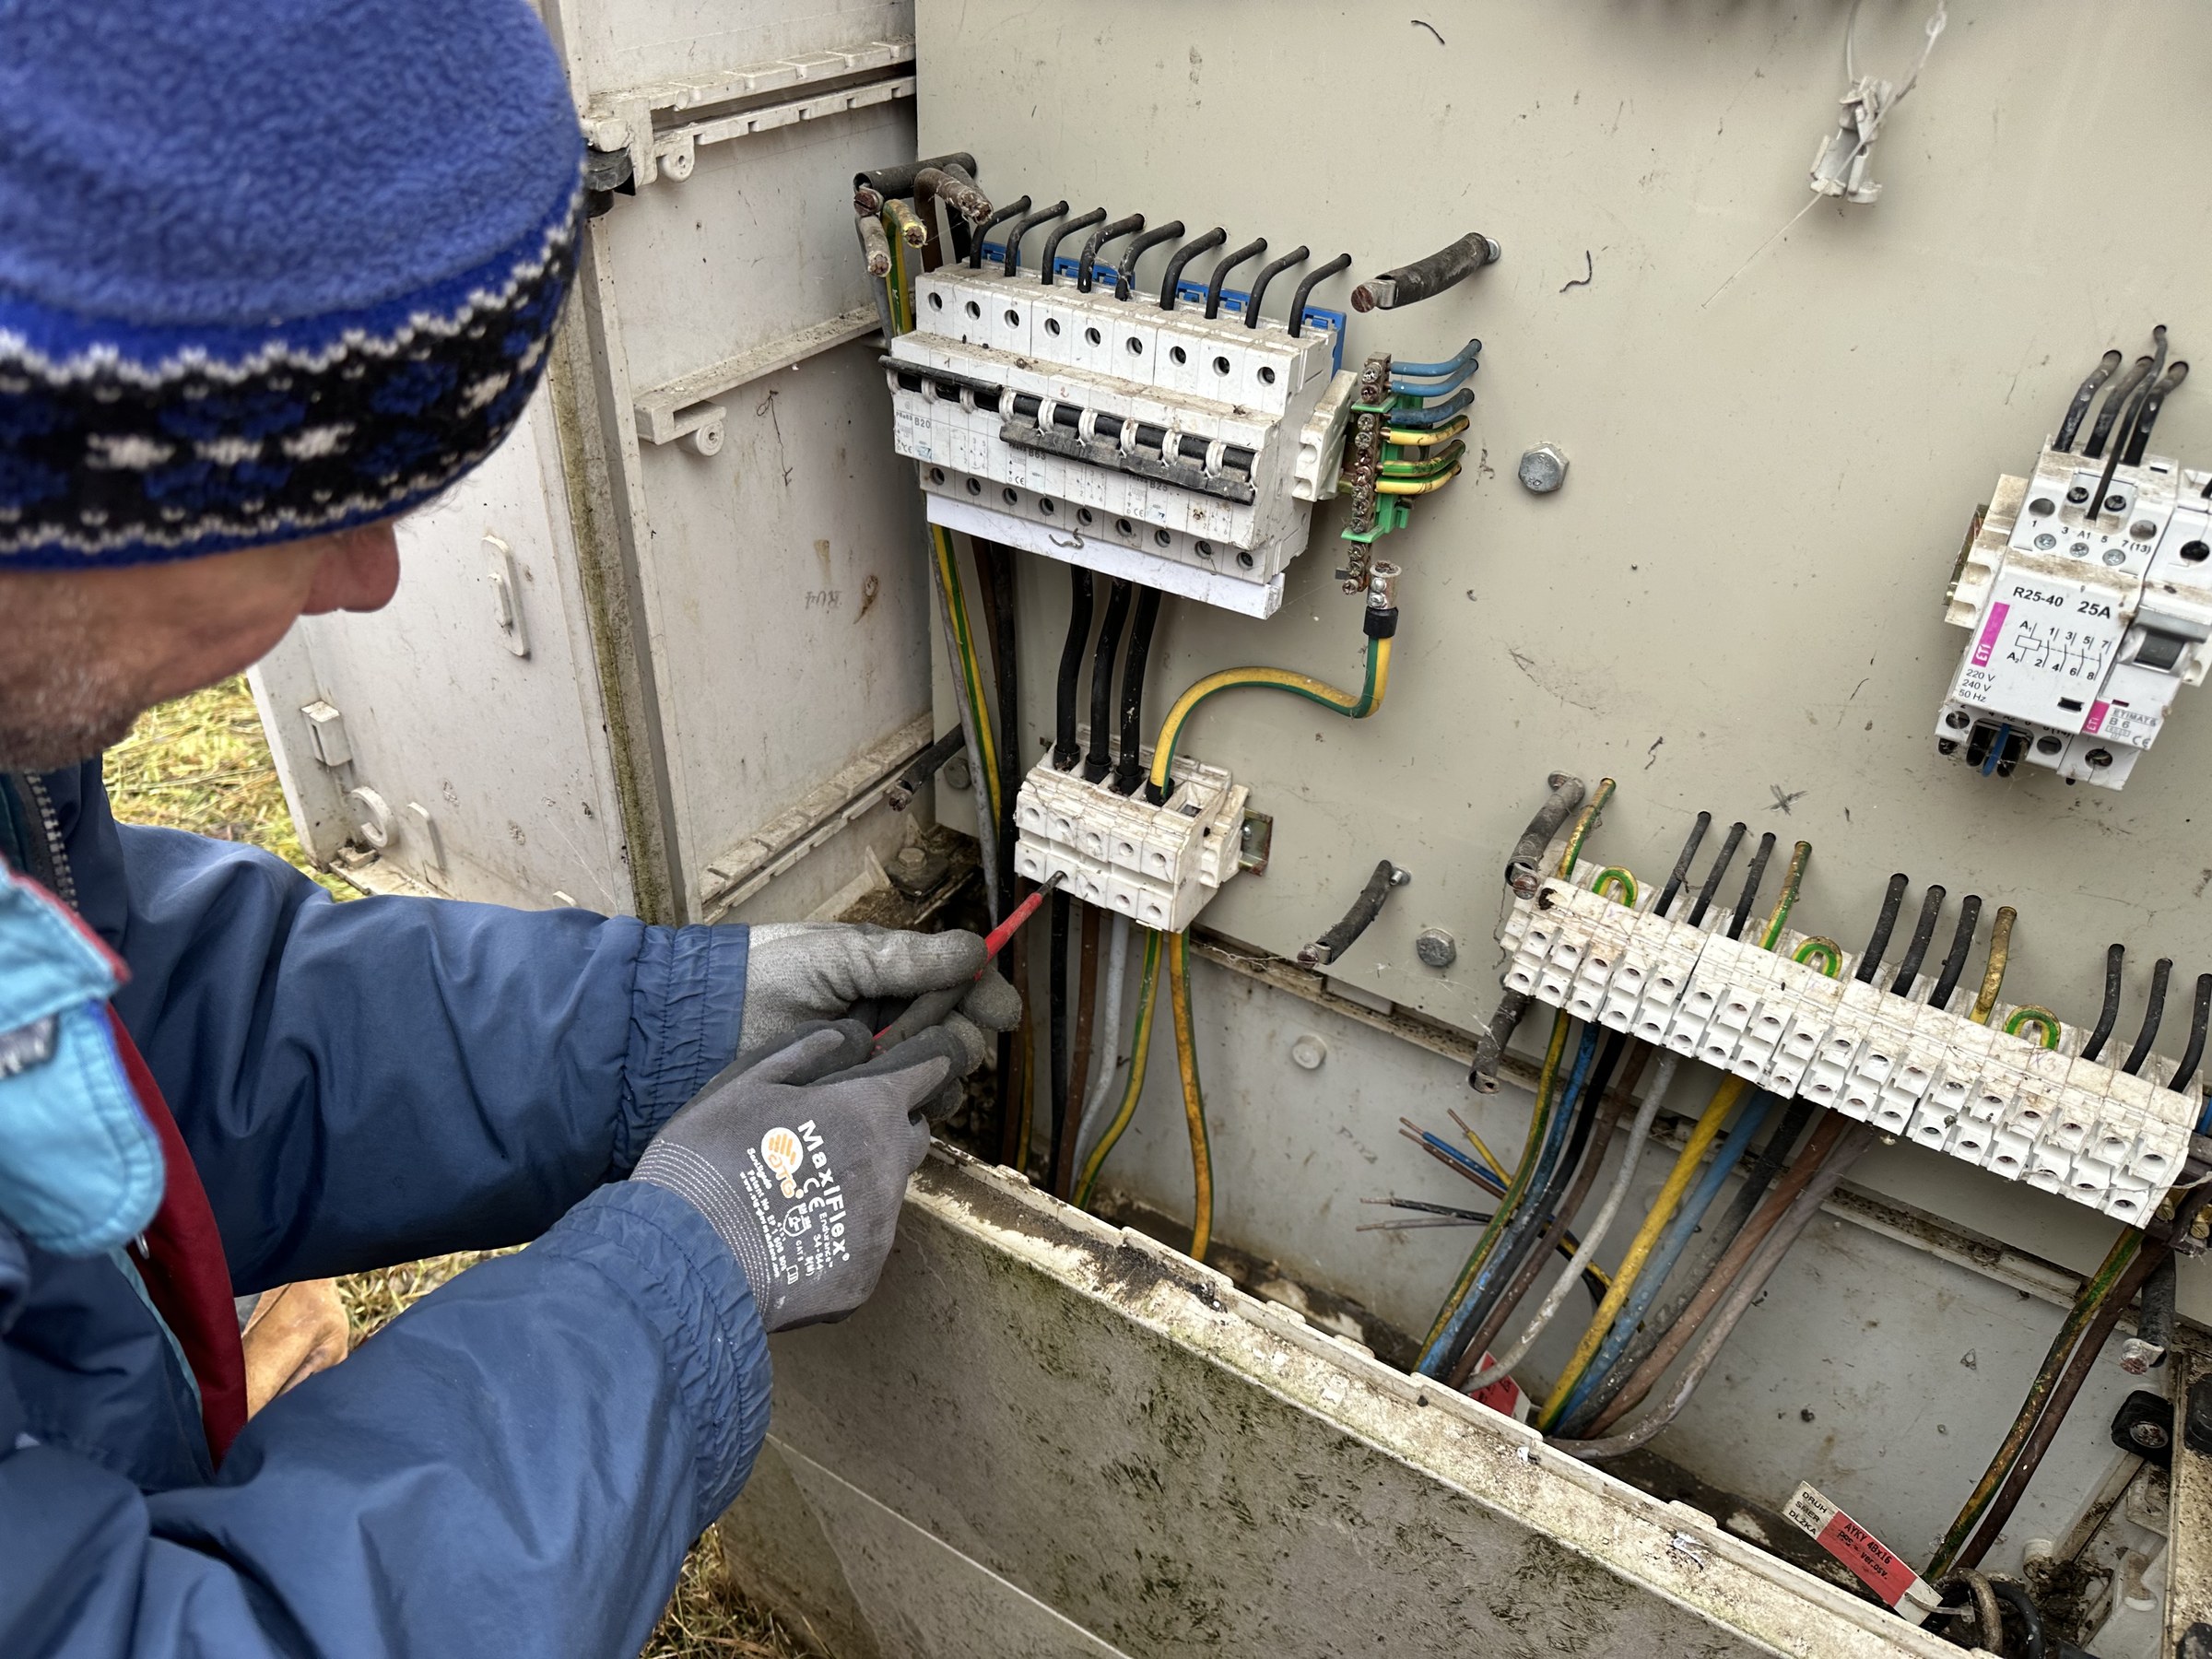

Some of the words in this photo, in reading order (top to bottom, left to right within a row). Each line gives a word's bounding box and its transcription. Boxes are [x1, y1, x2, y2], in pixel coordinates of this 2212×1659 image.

[914, 418, 931, 429] B20
[2031, 520, 2038, 528] 1
[2061, 526, 2069, 535] 3
[2077, 530, 2091, 540] A1
[2100, 535, 2109, 544] 5
[2122, 539, 2129, 547] 7
[2129, 541, 2152, 555] (13)
[2012, 586, 2064, 607] R25-40
[2077, 600, 2112, 619] 25A
[2065, 631, 2073, 641] 3
[2082, 636, 2091, 645] 5
[1975, 643, 1992, 662] ETI
[1966, 668, 1985, 680] 220
[1987, 673, 1996, 682] V
[2034, 658, 2042, 667] 2
[2052, 663, 2060, 672] 4
[2069, 667, 2077, 677] 6
[2087, 671, 2095, 680] 8
[1961, 678, 1981, 690] 240
[1983, 683, 1992, 692] V
[1958, 688, 1971, 699] 50
[1972, 692, 1987, 703] Hz
[2086, 717, 2100, 731] ETI
[2109, 717, 2119, 726] B
[2122, 720, 2131, 729] 6
[2132, 735, 2152, 748] CE
[747, 1169, 765, 1200] Patent
[803, 1177, 826, 1213] CE
[1794, 1500, 1820, 1523] SMER
[1802, 1491, 1828, 1513] DRUH
[1844, 1523, 1868, 1542] AYKY
[1866, 1540, 1892, 1565] 4Bx16
[1860, 1551, 1888, 1580] ver.osv.
